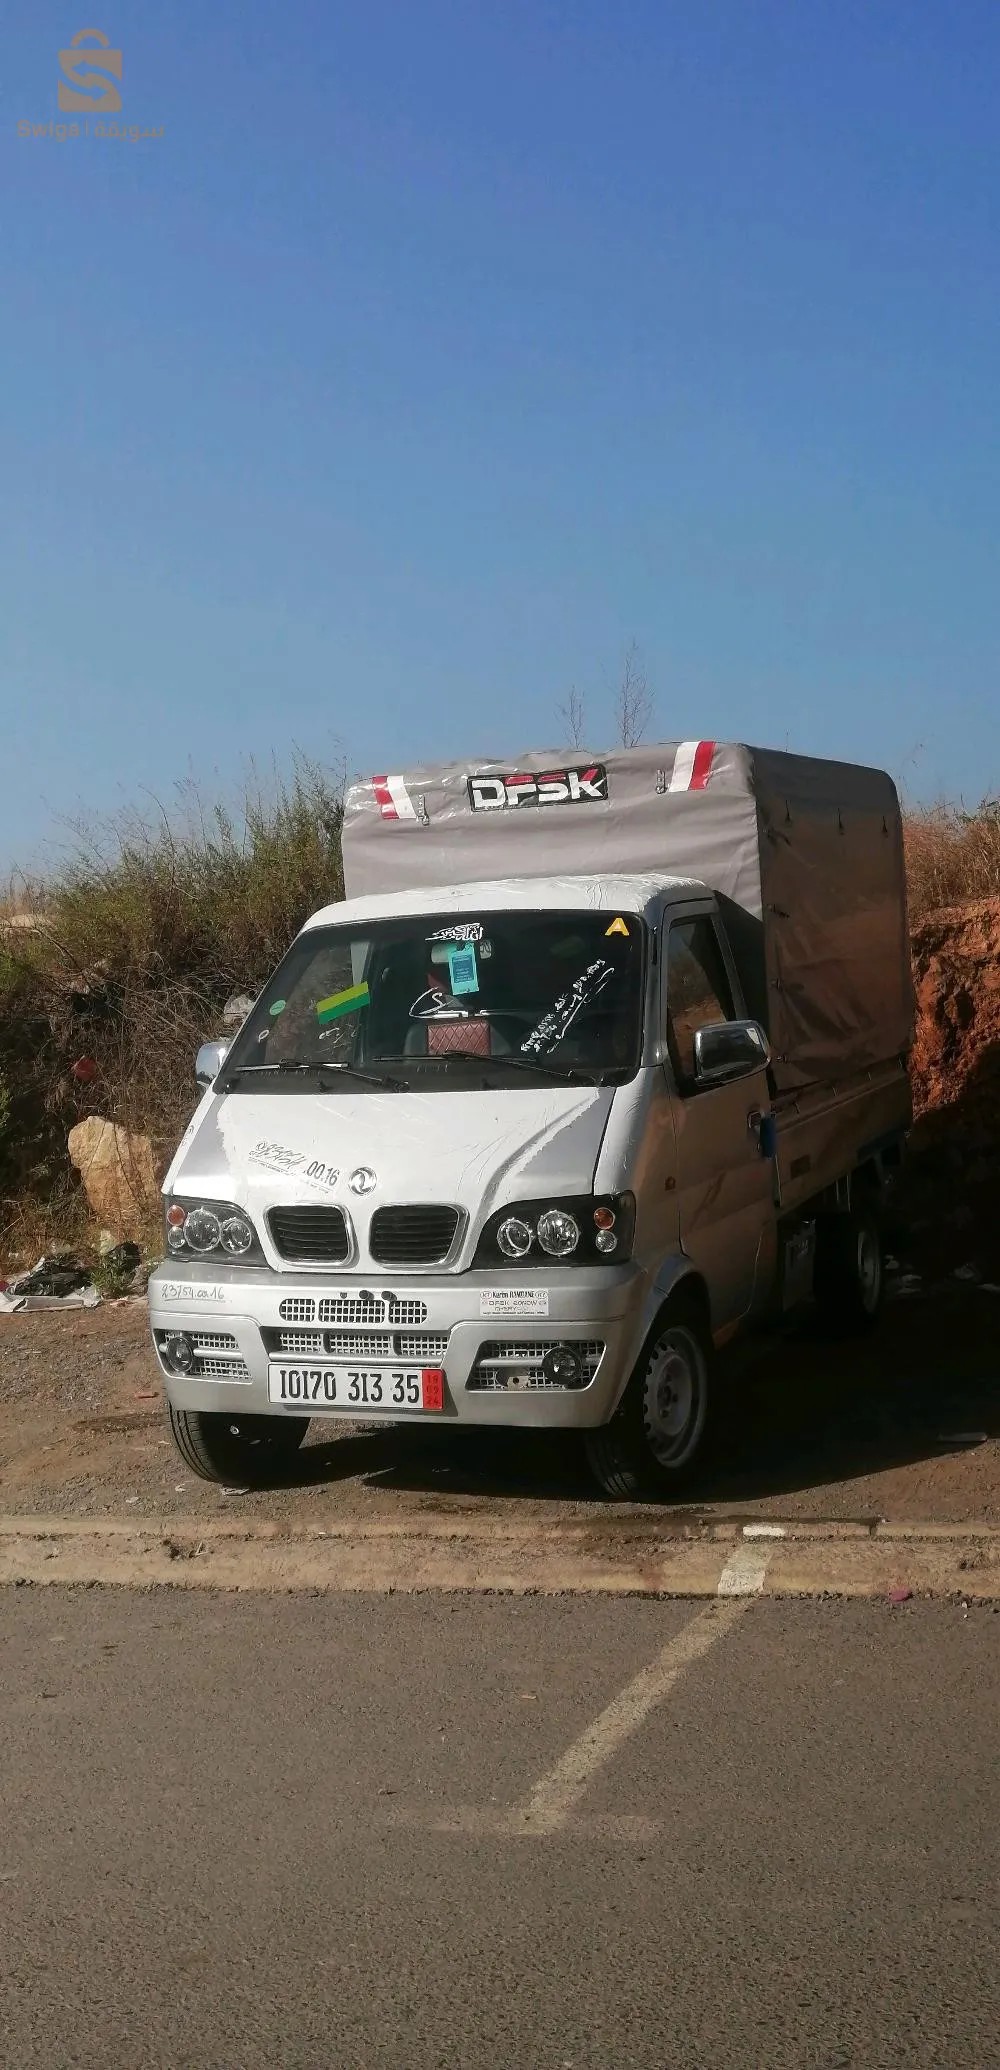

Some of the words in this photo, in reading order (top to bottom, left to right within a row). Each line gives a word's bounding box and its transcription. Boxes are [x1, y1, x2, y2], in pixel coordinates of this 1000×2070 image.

[471, 768, 604, 808] DFSK
[604, 917, 630, 936] A
[279, 1369, 337, 1401] 10170
[347, 1372, 383, 1402] 313
[391, 1373, 420, 1404] 35
